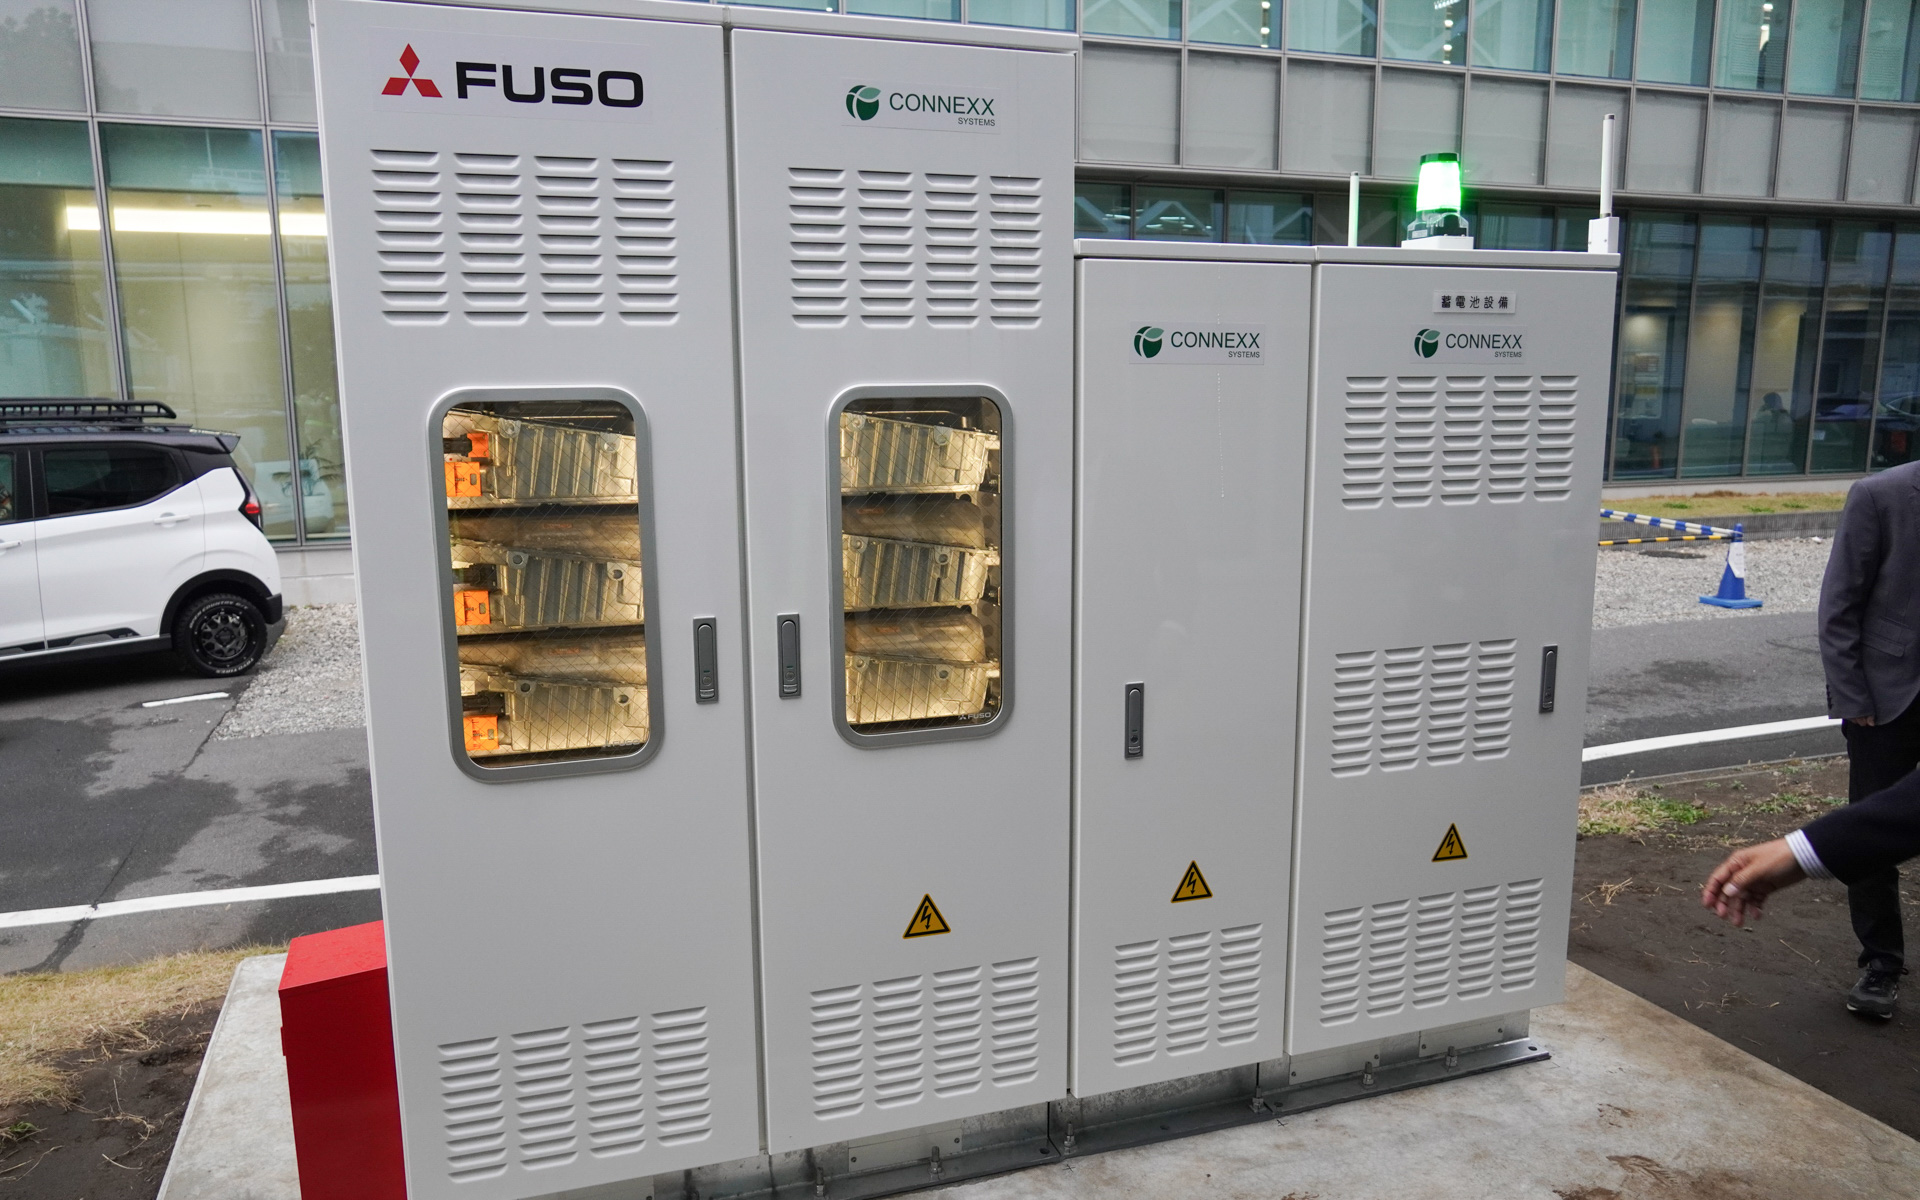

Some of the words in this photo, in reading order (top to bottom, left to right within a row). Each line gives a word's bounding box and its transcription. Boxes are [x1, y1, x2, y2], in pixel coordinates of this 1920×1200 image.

[456, 61, 644, 108] FUSO
[889, 92, 995, 116] CONNEXX
[957, 117, 996, 127] SYSTEMS
[1441, 295, 1509, 309] 蓄電池設備
[1170, 331, 1260, 349] CONNEXX
[1445, 333, 1523, 349] CONNEXX
[1228, 351, 1260, 359] SYSTEMS
[967, 711, 992, 720] FUSO
